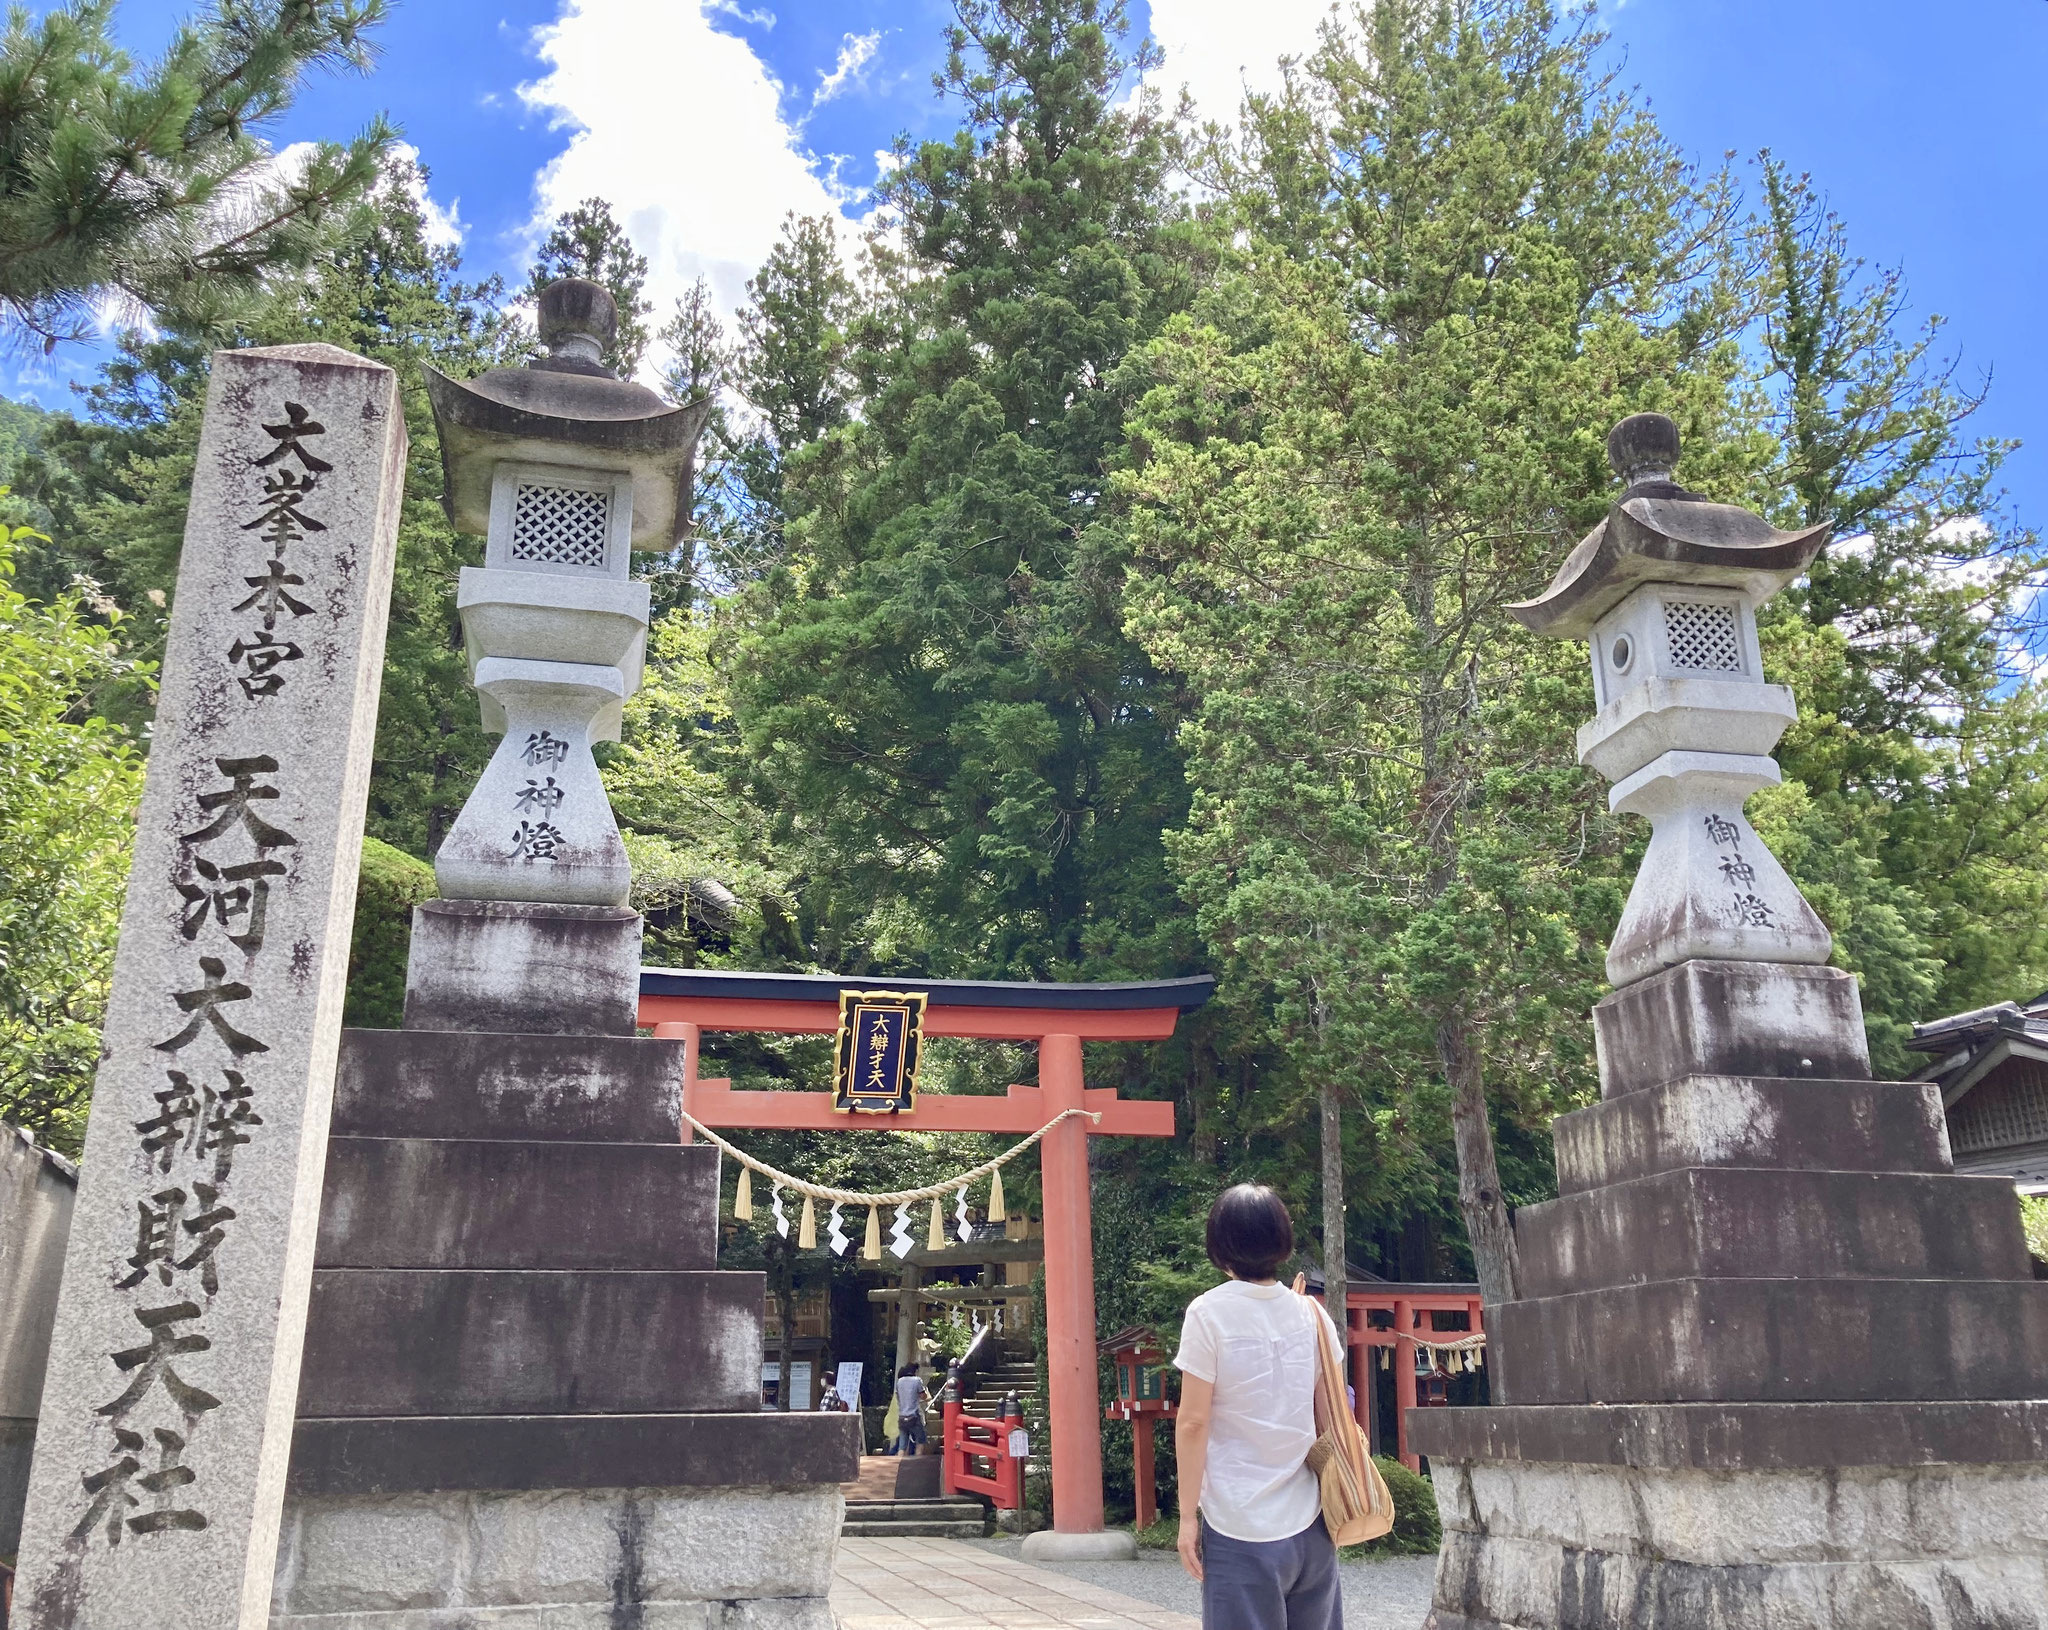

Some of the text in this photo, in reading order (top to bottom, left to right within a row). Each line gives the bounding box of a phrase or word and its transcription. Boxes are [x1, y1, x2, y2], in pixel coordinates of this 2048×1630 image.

[228, 401, 333, 701] 大峯本宮
[506, 730, 570, 861] 御神燈
[1703, 813, 1775, 929] 御神燈
